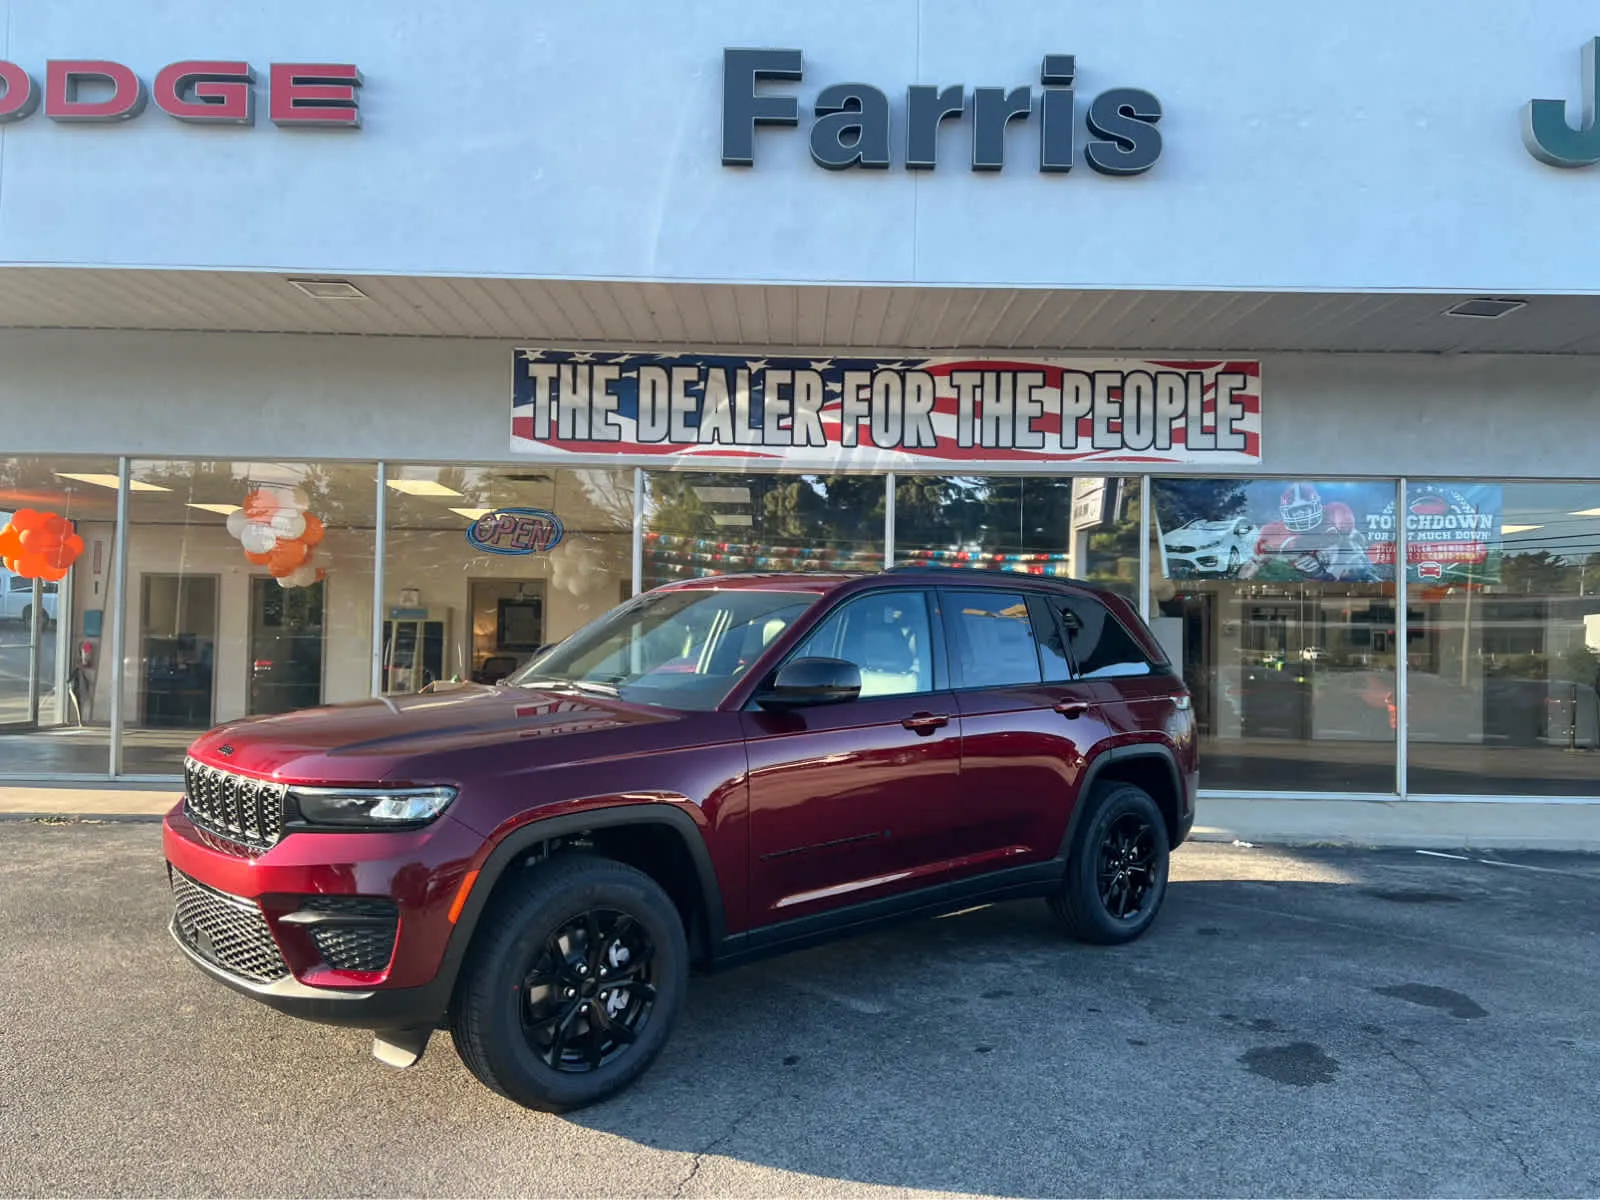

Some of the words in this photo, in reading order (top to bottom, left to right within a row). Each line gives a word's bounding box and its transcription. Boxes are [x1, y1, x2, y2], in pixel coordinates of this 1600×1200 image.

[721, 47, 1163, 175] Farris
[528, 362, 621, 442] THE
[636, 364, 827, 449] DEALER
[841, 368, 937, 449] FOR
[950, 370, 1047, 449] THE
[1059, 369, 1247, 451] PEOPLE
[475, 512, 554, 551] OPEN
[1366, 514, 1493, 529] TOCHDOWN
[1368, 532, 1389, 541] FOR
[1417, 532, 1450, 541] MUCH
